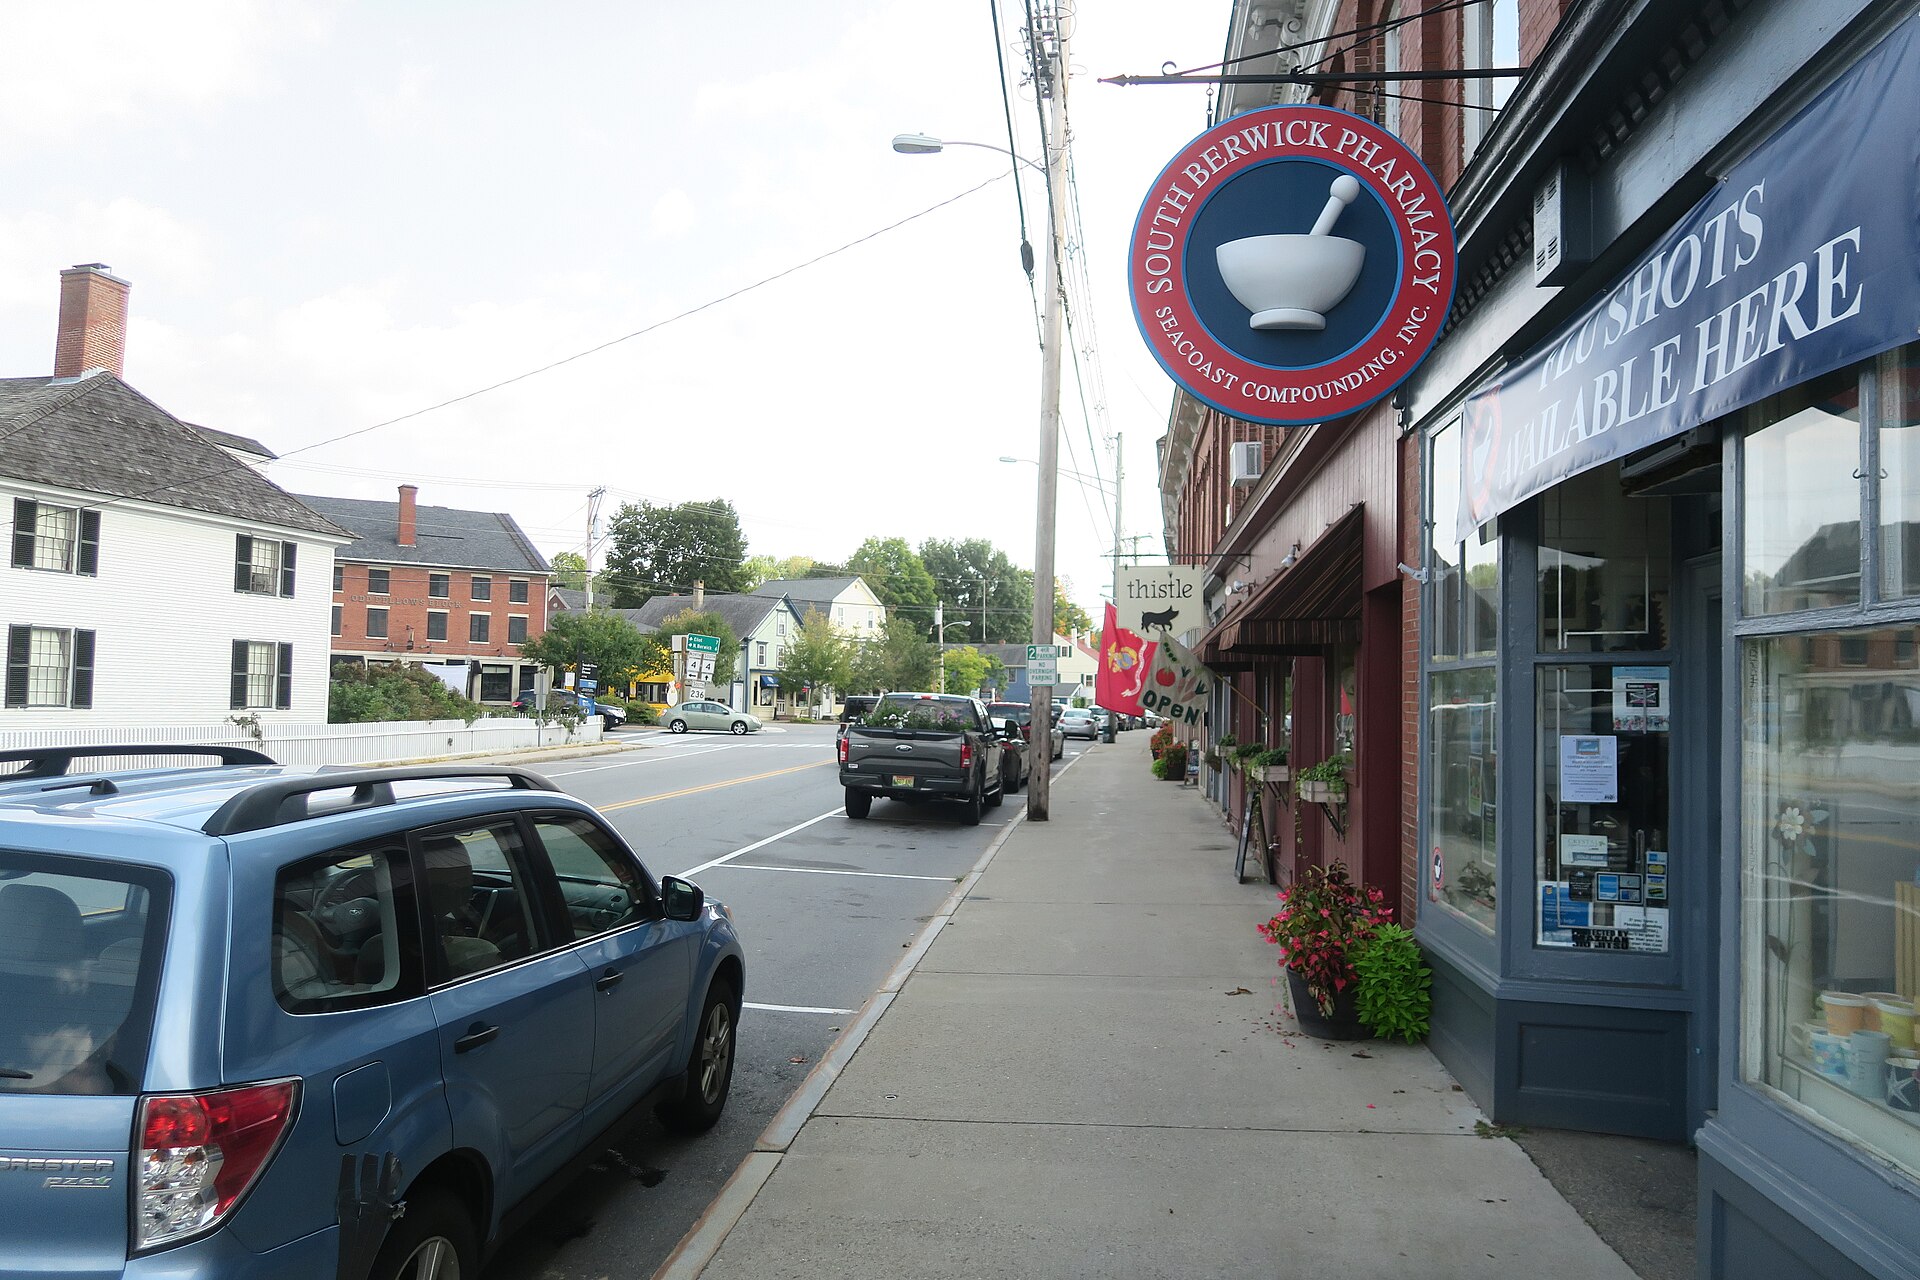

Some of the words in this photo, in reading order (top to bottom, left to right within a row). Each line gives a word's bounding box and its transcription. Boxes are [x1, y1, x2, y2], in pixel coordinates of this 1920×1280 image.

[1146, 182, 1194, 295] SOUTH
[1182, 120, 1332, 189] BERWICK
[1336, 128, 1443, 296] PHARMACY
[1603, 178, 1766, 350] SHOTS
[1155, 305, 1238, 390] SEACOAST
[1241, 347, 1405, 403] COMPOUNDING,
[1395, 305, 1431, 345] INC.
[1499, 335, 1680, 489] AVAILABLE
[1690, 226, 1864, 396] HERE
[1127, 577, 1193, 599] thistle
[691, 661, 697, 669] 4
[1029, 648, 1036, 660] 2
[705, 663, 711, 671] 4
[690, 690, 705, 699] 236
